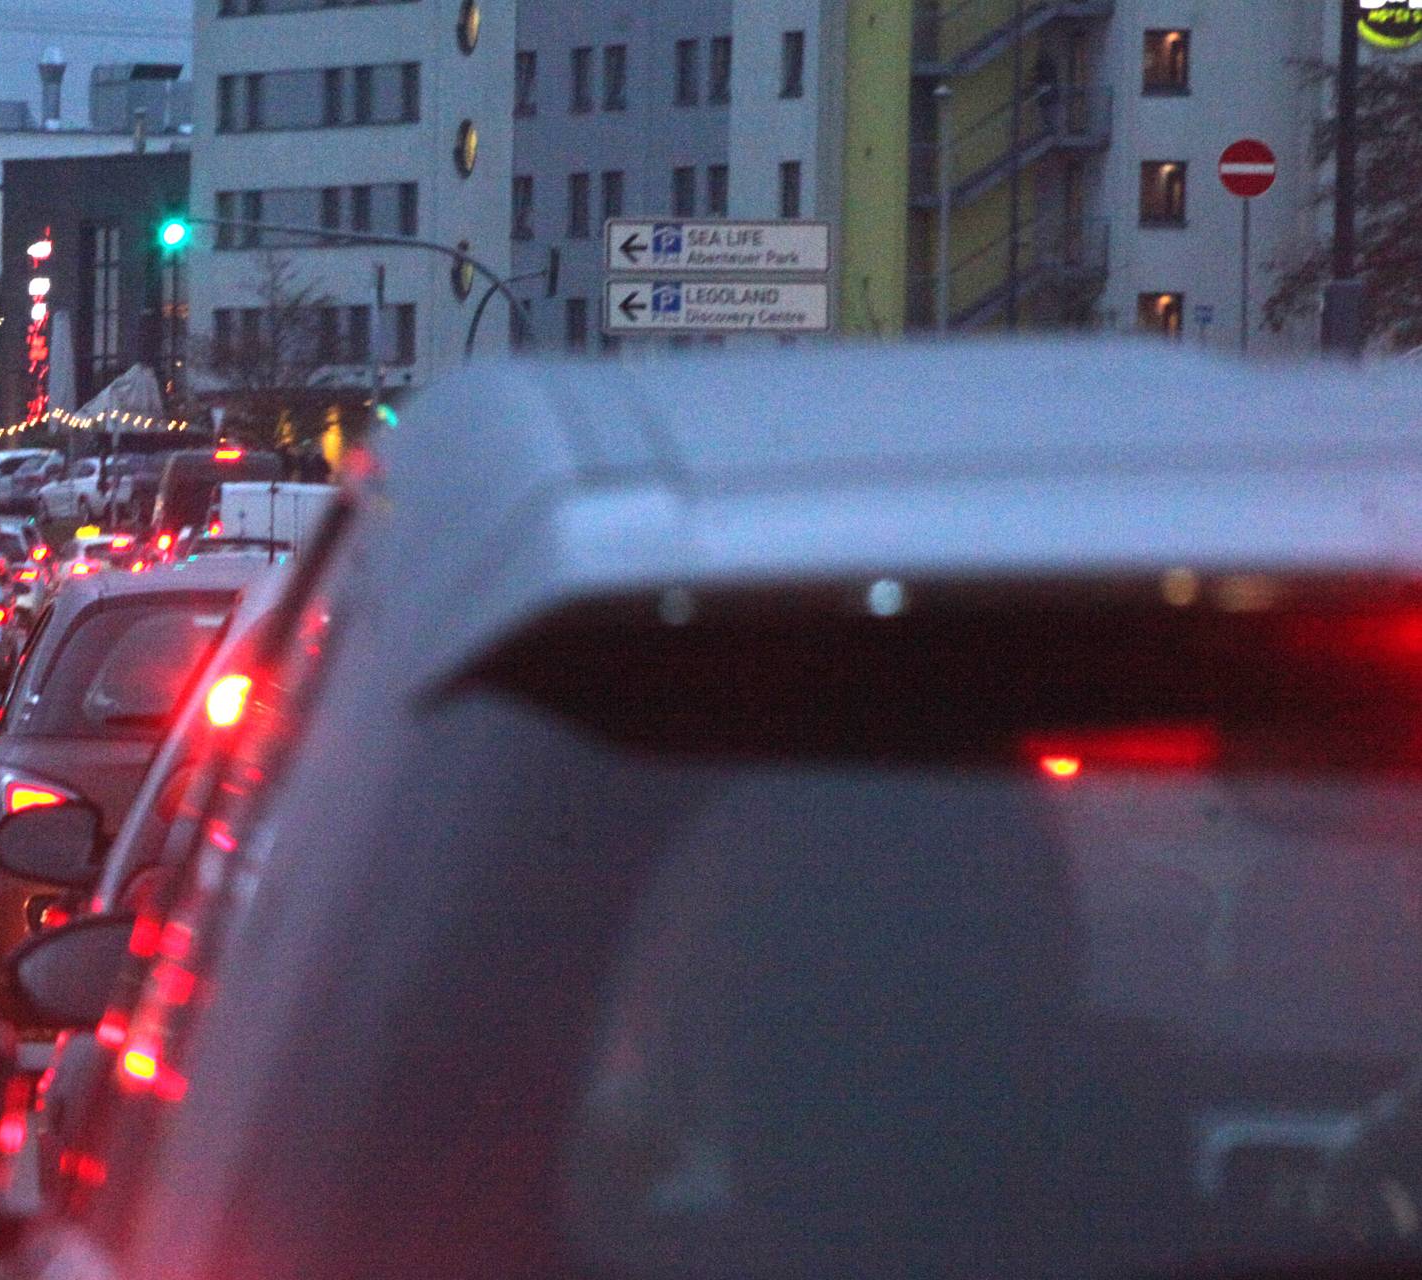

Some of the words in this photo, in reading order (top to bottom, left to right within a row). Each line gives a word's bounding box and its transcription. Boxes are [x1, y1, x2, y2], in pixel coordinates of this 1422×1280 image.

[687, 228, 721, 246] SEA
[727, 228, 764, 246] LIFE
[686, 250, 762, 264] Abenteuer
[765, 250, 800, 264] Park
[685, 287, 780, 304] LEGOLAND
[685, 310, 755, 325] Discovery
